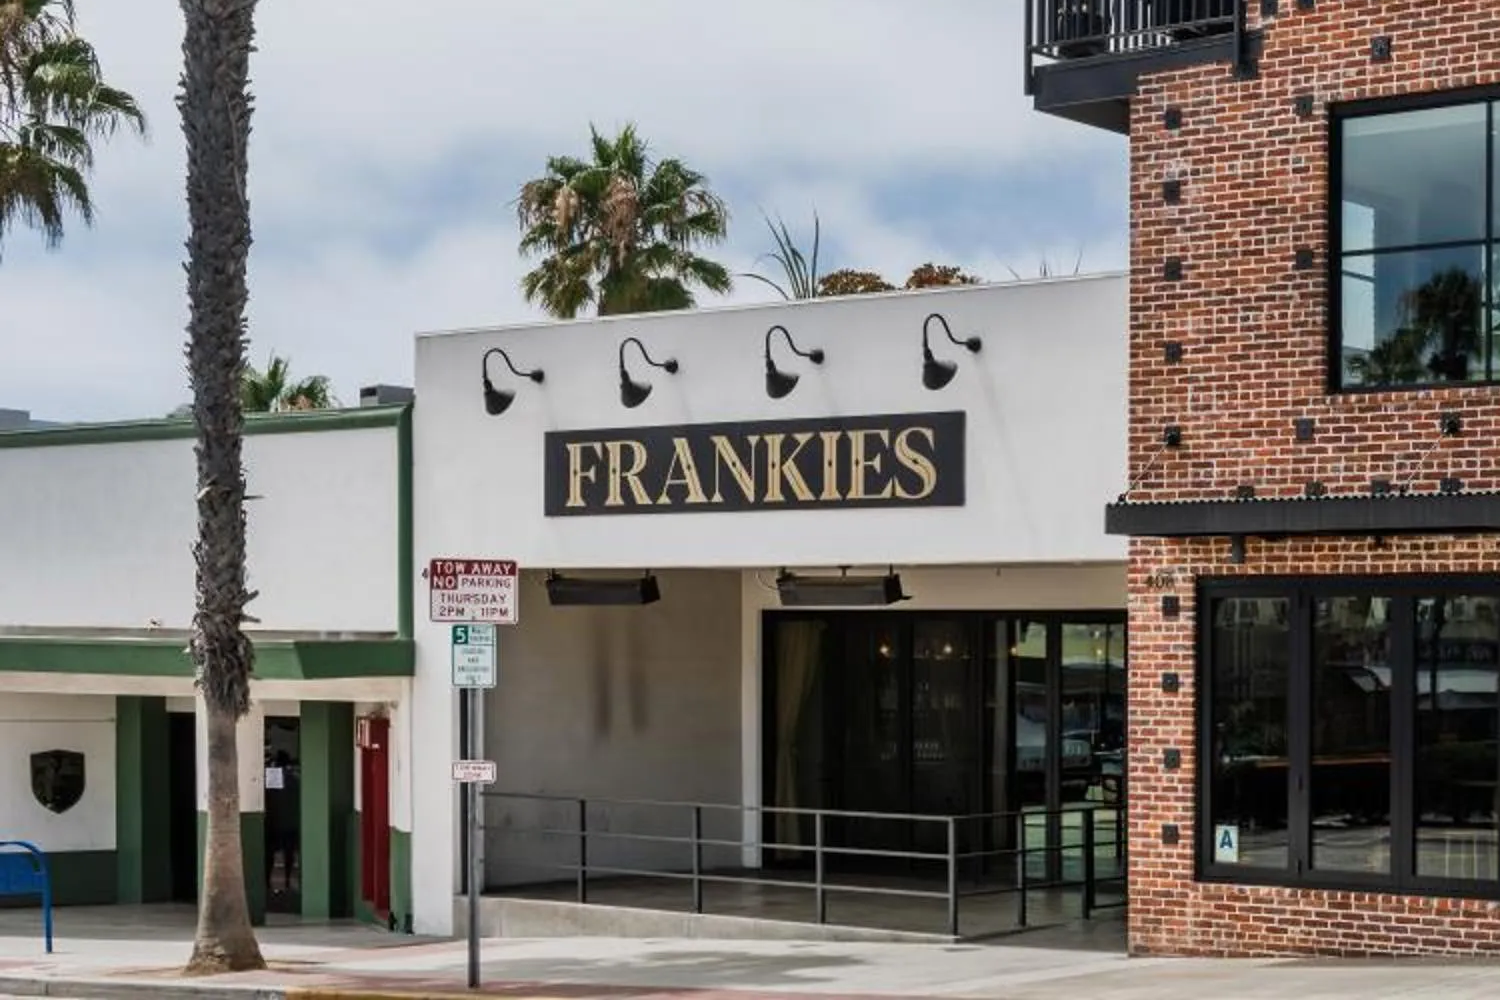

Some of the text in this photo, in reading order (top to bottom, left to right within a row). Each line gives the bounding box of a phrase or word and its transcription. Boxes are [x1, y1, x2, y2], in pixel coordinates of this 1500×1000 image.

[565, 427, 938, 508] FRANKIES
[436, 562, 513, 576] TOW AWAY
[433, 575, 512, 589] NO PARKING
[440, 593, 507, 605] THURSDAY
[440, 605, 509, 617] 2PM 11PM
[455, 627, 467, 643] 5
[1219, 829, 1233, 849] A
